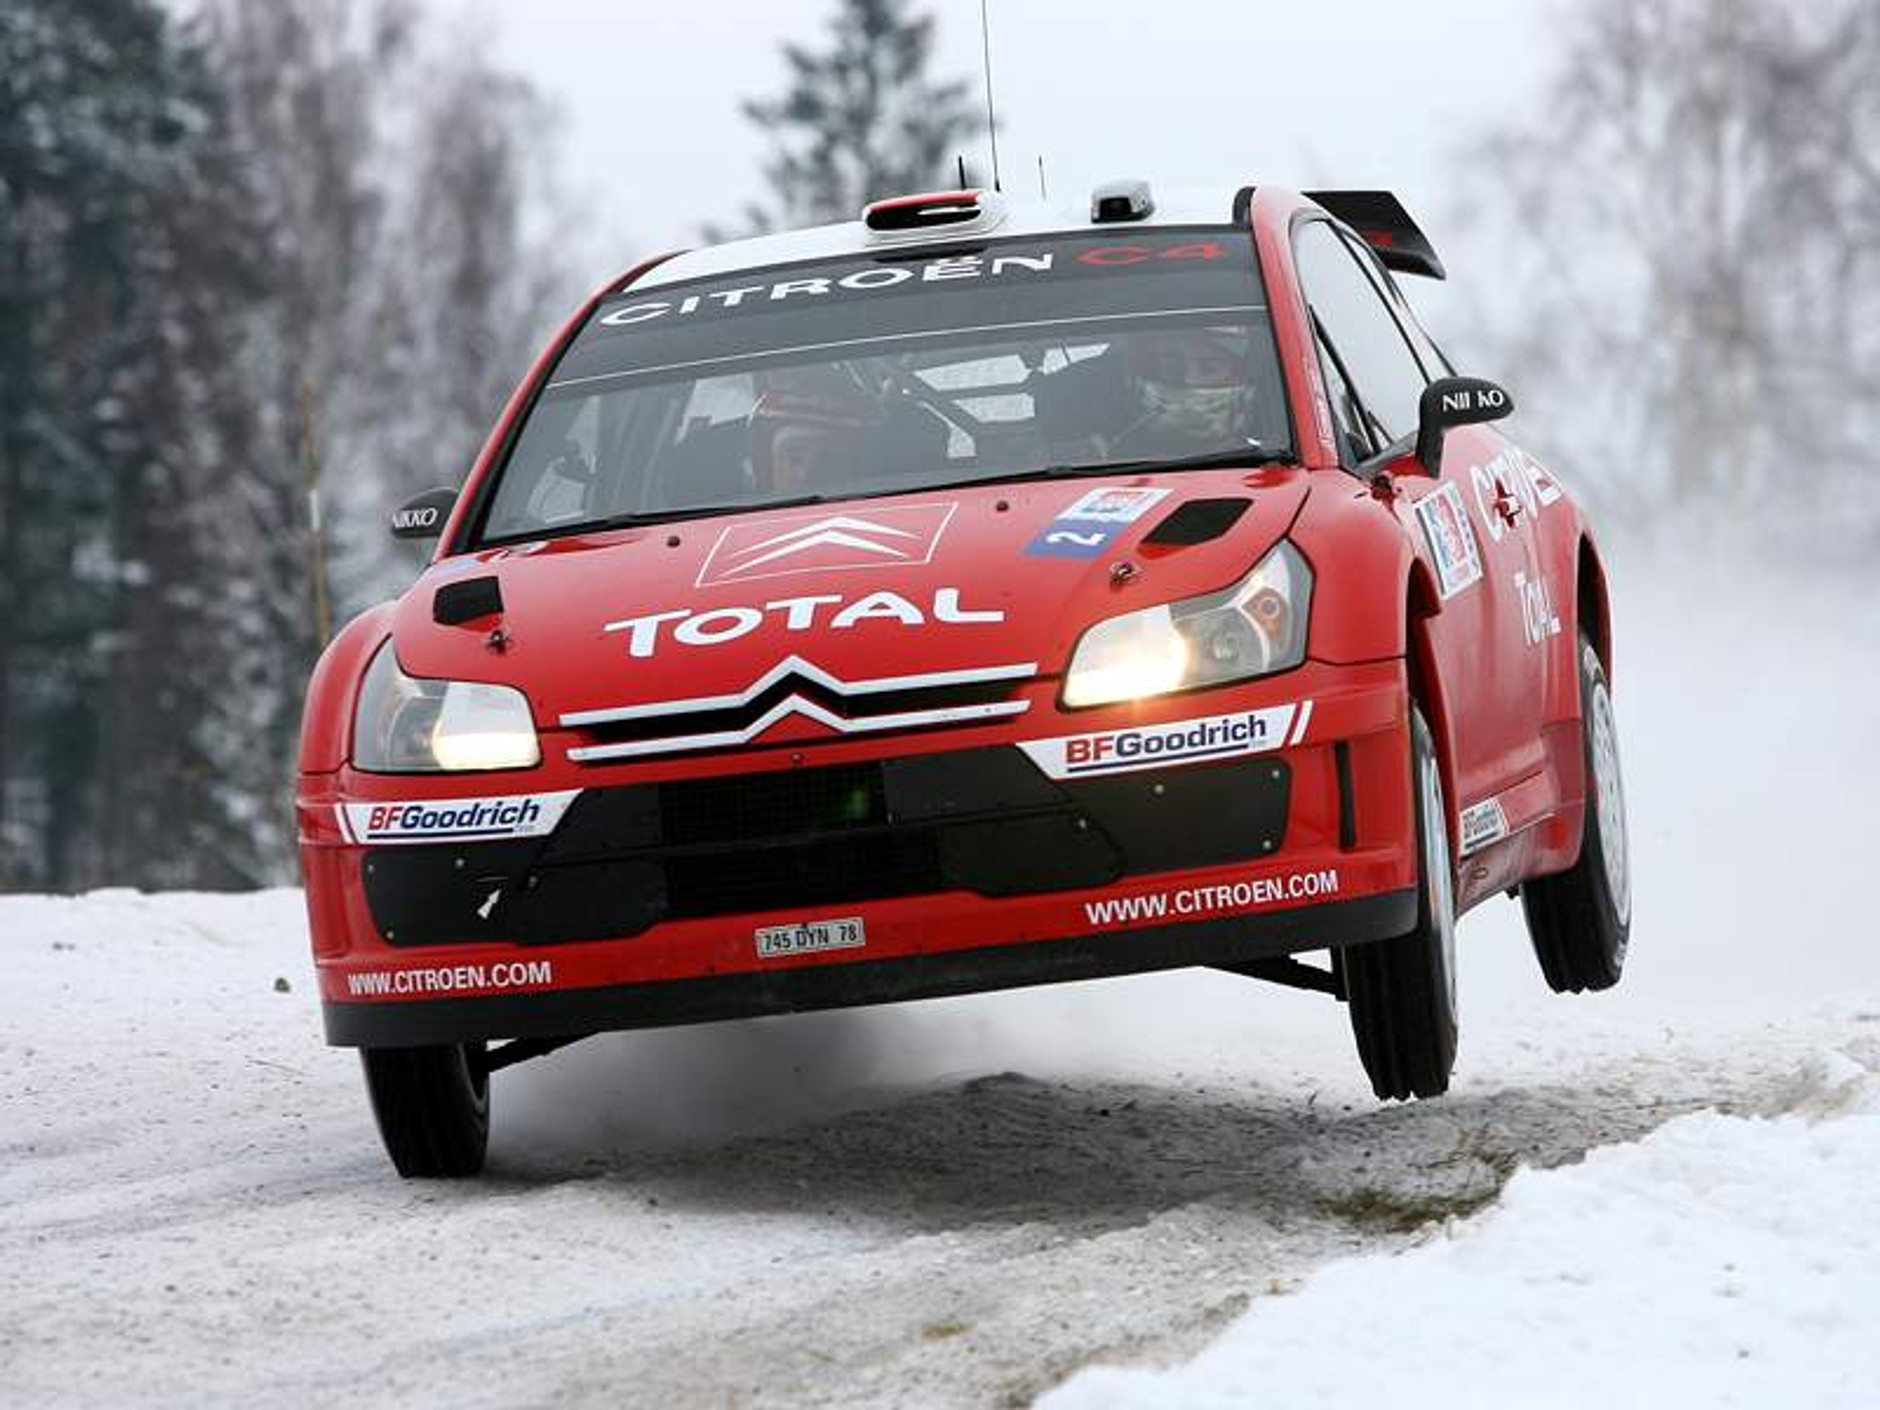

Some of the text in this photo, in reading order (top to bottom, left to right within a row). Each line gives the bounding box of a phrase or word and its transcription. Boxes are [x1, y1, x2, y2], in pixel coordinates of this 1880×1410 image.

[1079, 243, 1228, 266] C4
[604, 587, 1004, 658] TOTAL
[1065, 714, 1267, 764] BFGoodrich
[367, 799, 540, 831] BFGoodrich
[1085, 870, 1338, 925] WWW.CITROEN.COM
[795, 927, 829, 947] DYN
[839, 924, 857, 941] 78
[347, 961, 552, 995] WWW.CITROEN.COM
